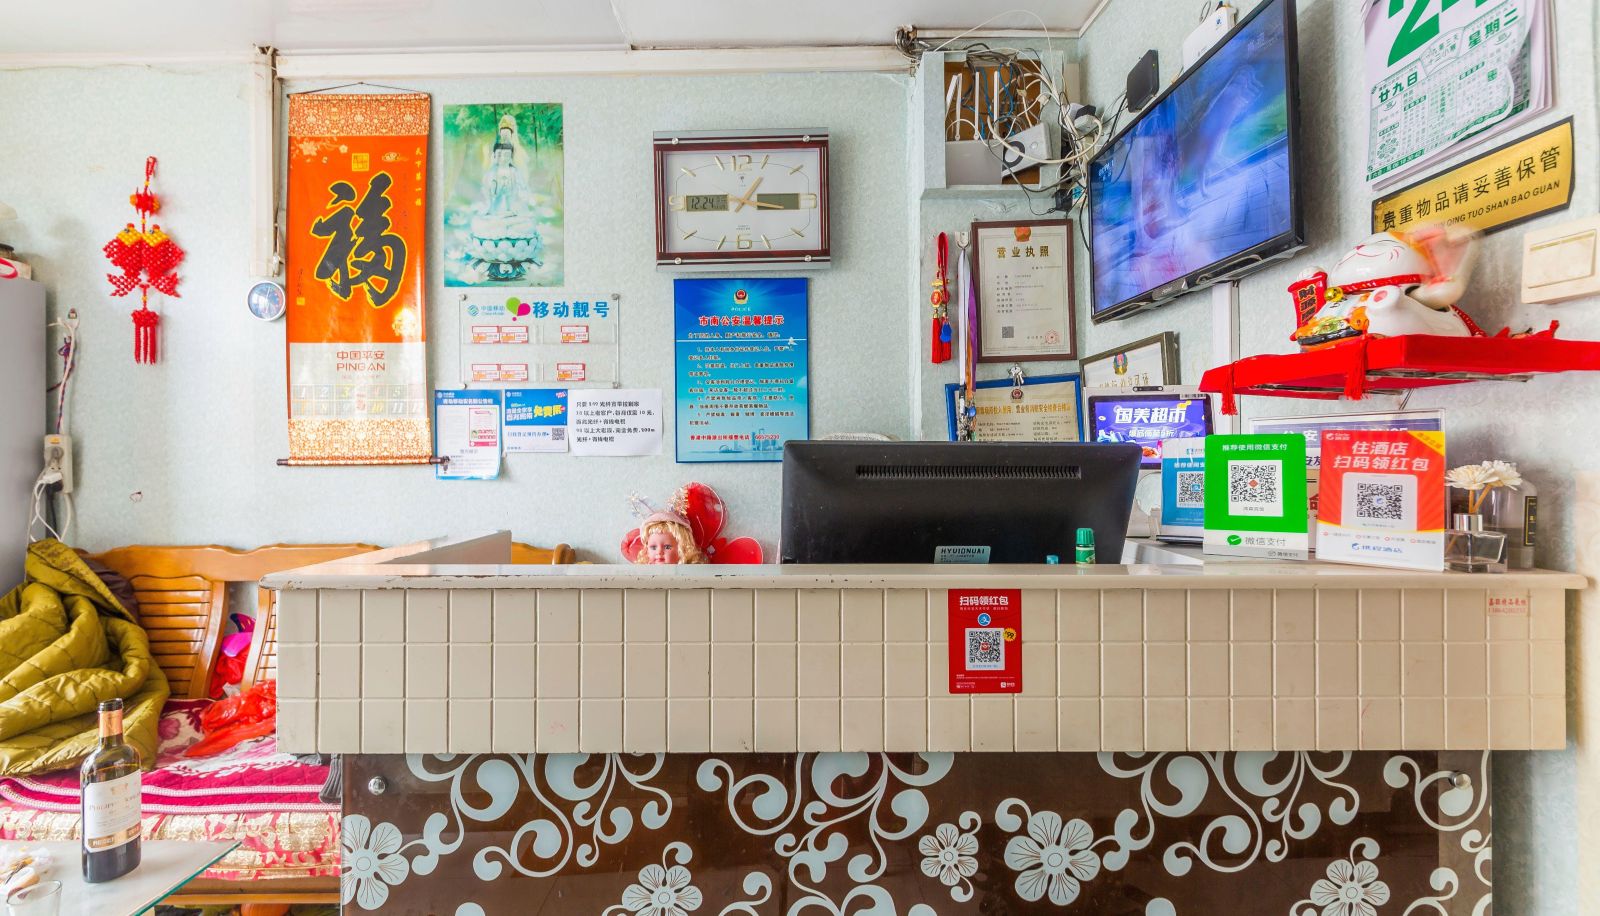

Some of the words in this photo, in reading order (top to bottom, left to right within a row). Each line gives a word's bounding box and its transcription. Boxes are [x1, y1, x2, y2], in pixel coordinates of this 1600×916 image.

[1469, 8, 1519, 49] 星期二
[1378, 71, 1418, 103] 廿九日
[732, 154, 753, 172] 12
[1382, 146, 1561, 232] 贵重物品请妥善保管
[1468, 206, 1485, 219] TUO
[1486, 199, 1509, 214] SHAN
[1511, 191, 1531, 205] BAO
[1532, 180, 1561, 197] GUAN
[310, 170, 409, 309] 福
[997, 245, 1050, 258] 营业执照
[532, 301, 610, 319] 移动靓号
[699, 315, 785, 327] 市南公安温馨提示
[336, 350, 385, 361] 中国平安
[336, 362, 366, 372] PING
[367, 362, 386, 372] AN
[1114, 407, 1187, 424] 国美超市
[1222, 443, 1288, 451] 推荐使用微信支付
[1352, 441, 1409, 456] 住酒店
[1333, 455, 1430, 472] 扫码领红包
[1245, 536, 1287, 547] 微信支付
[959, 595, 1009, 606] 扫码领红包
